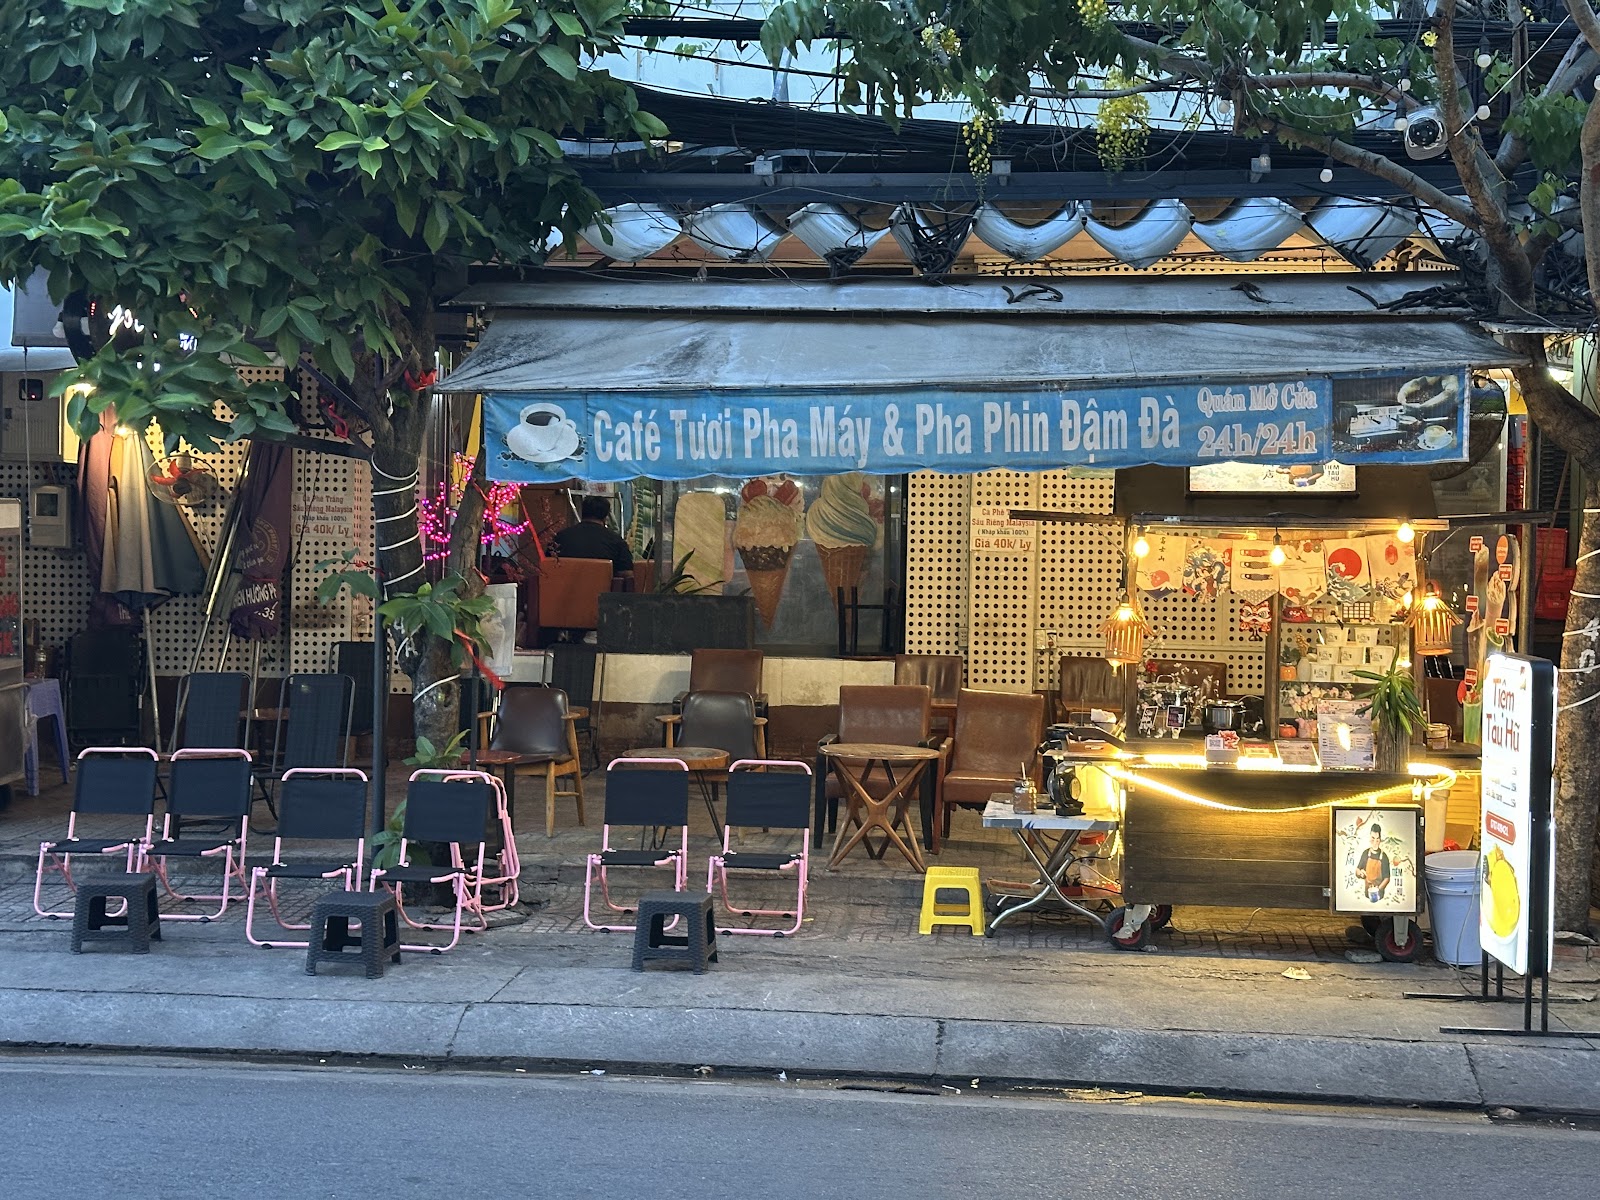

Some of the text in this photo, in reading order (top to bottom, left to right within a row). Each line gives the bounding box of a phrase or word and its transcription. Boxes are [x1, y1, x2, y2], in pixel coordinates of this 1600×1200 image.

[1197, 381, 1318, 418] Quán Mở Cửa
[593, 395, 1180, 468] Café Tươi Pha Máy & Pha Phin Đậm Đà
[1197, 421, 1318, 457] 24h/24h
[1006, 518, 1035, 528] Malaysia
[975, 538, 991, 548] Giá
[1492, 677, 1516, 719] Tiệm
[1486, 712, 1521, 753] Tàu Hũ
